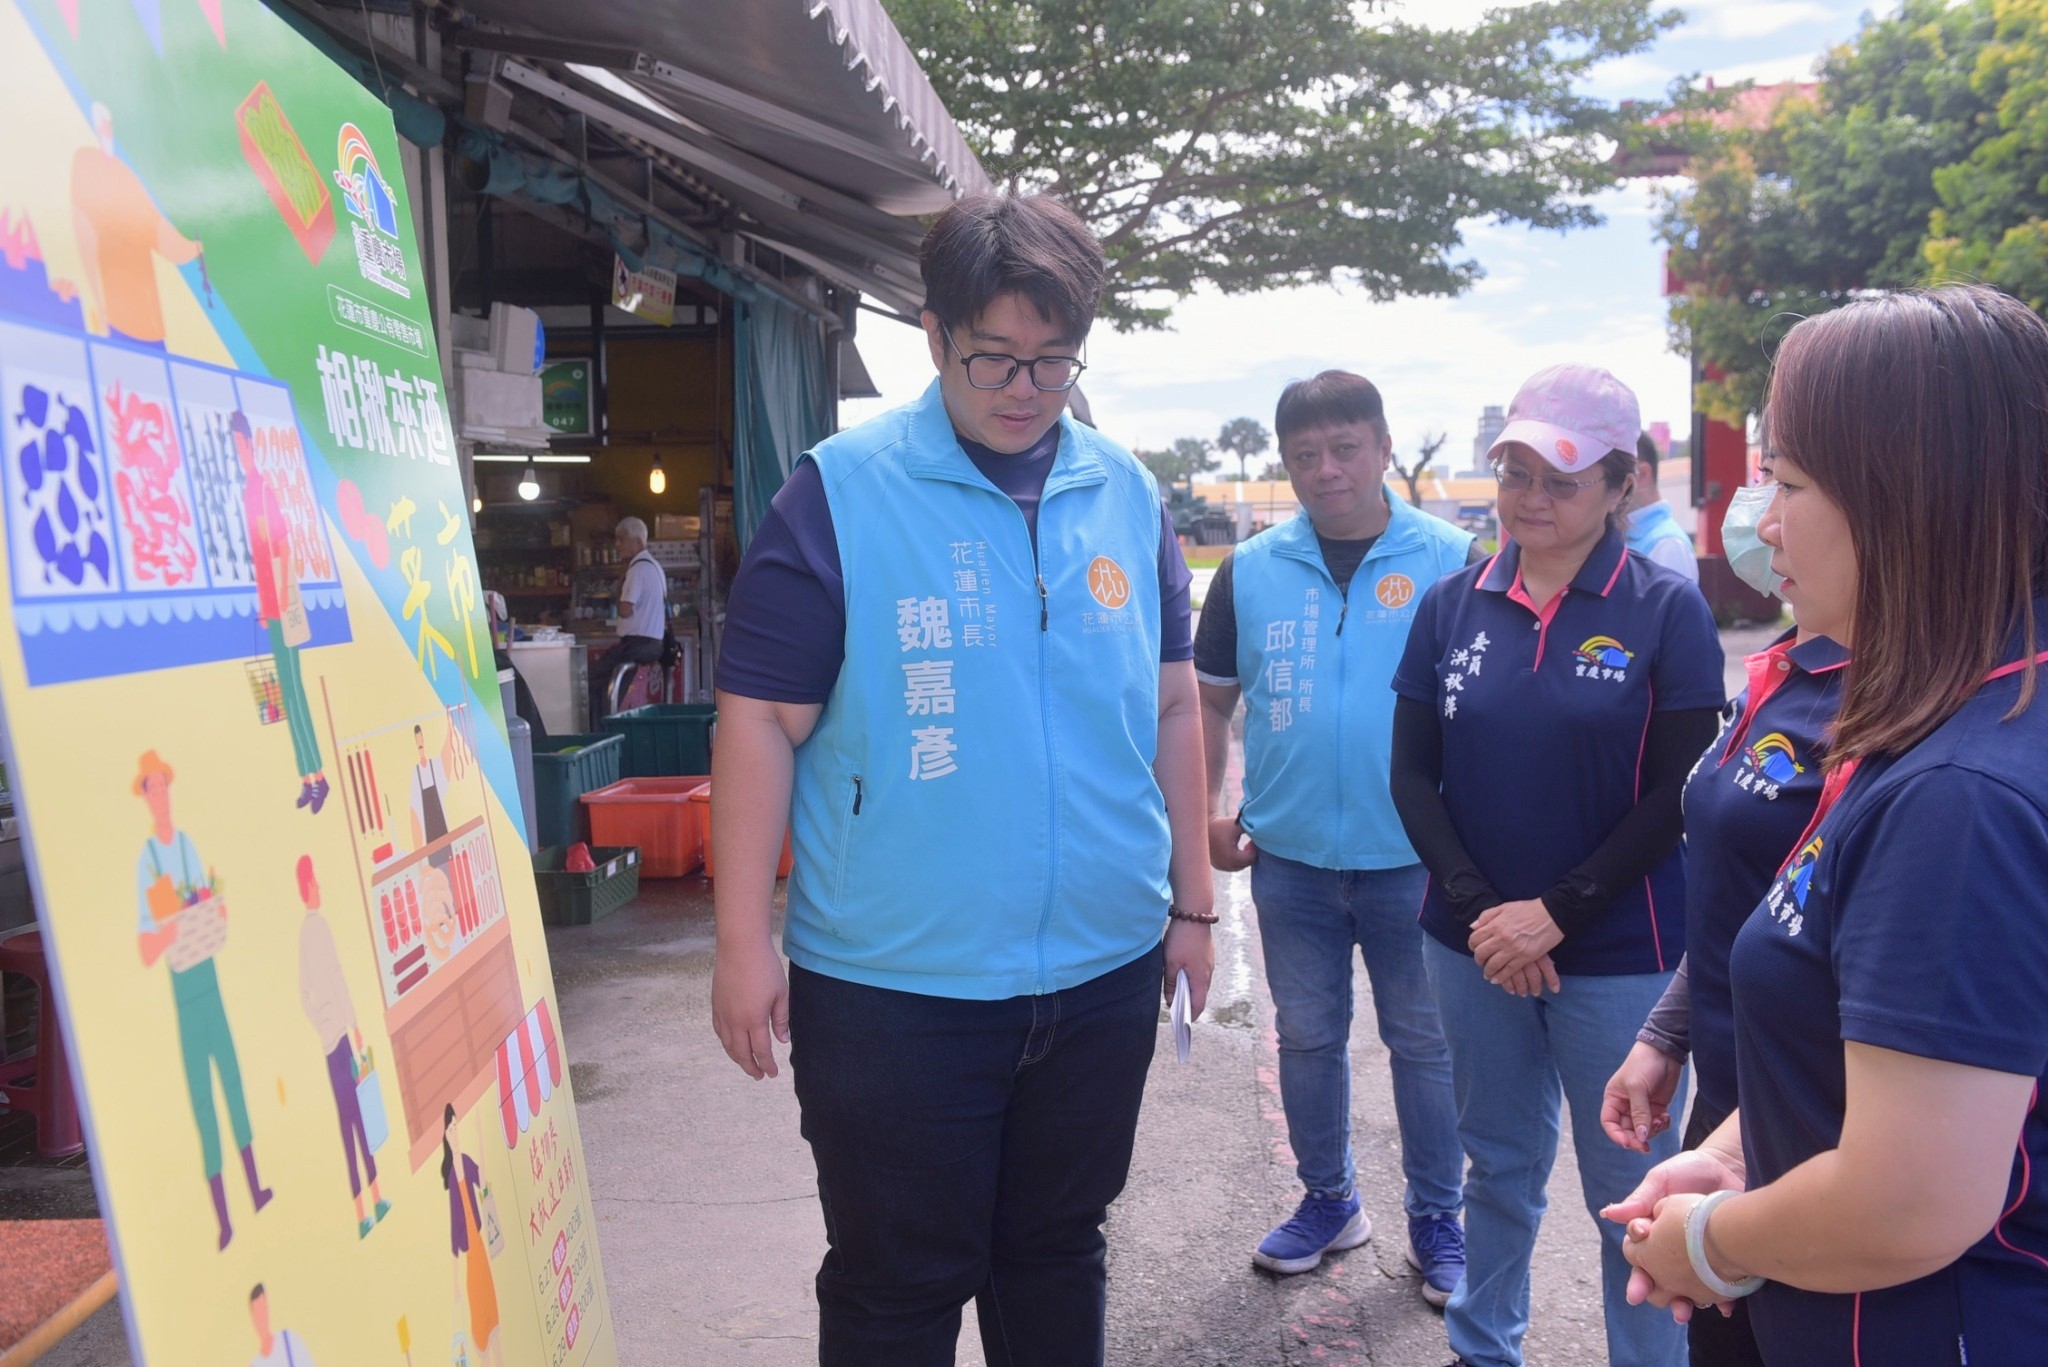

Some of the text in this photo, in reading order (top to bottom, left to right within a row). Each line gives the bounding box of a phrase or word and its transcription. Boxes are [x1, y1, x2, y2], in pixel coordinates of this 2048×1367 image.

[552, 417, 575, 427] 047
[949, 541, 985, 647] 花蓮市長
[975, 541, 997, 648] Hualien Mayor
[896, 595, 959, 782] 魏嘉彥
[1265, 620, 1297, 733] 邱信都
[1297, 588, 1321, 713] 市場管理所 所長
[1574, 663, 1626, 684] 重慶市場
[538, 1258, 552, 1295] 6.27
[545, 1297, 561, 1335] 6.28
